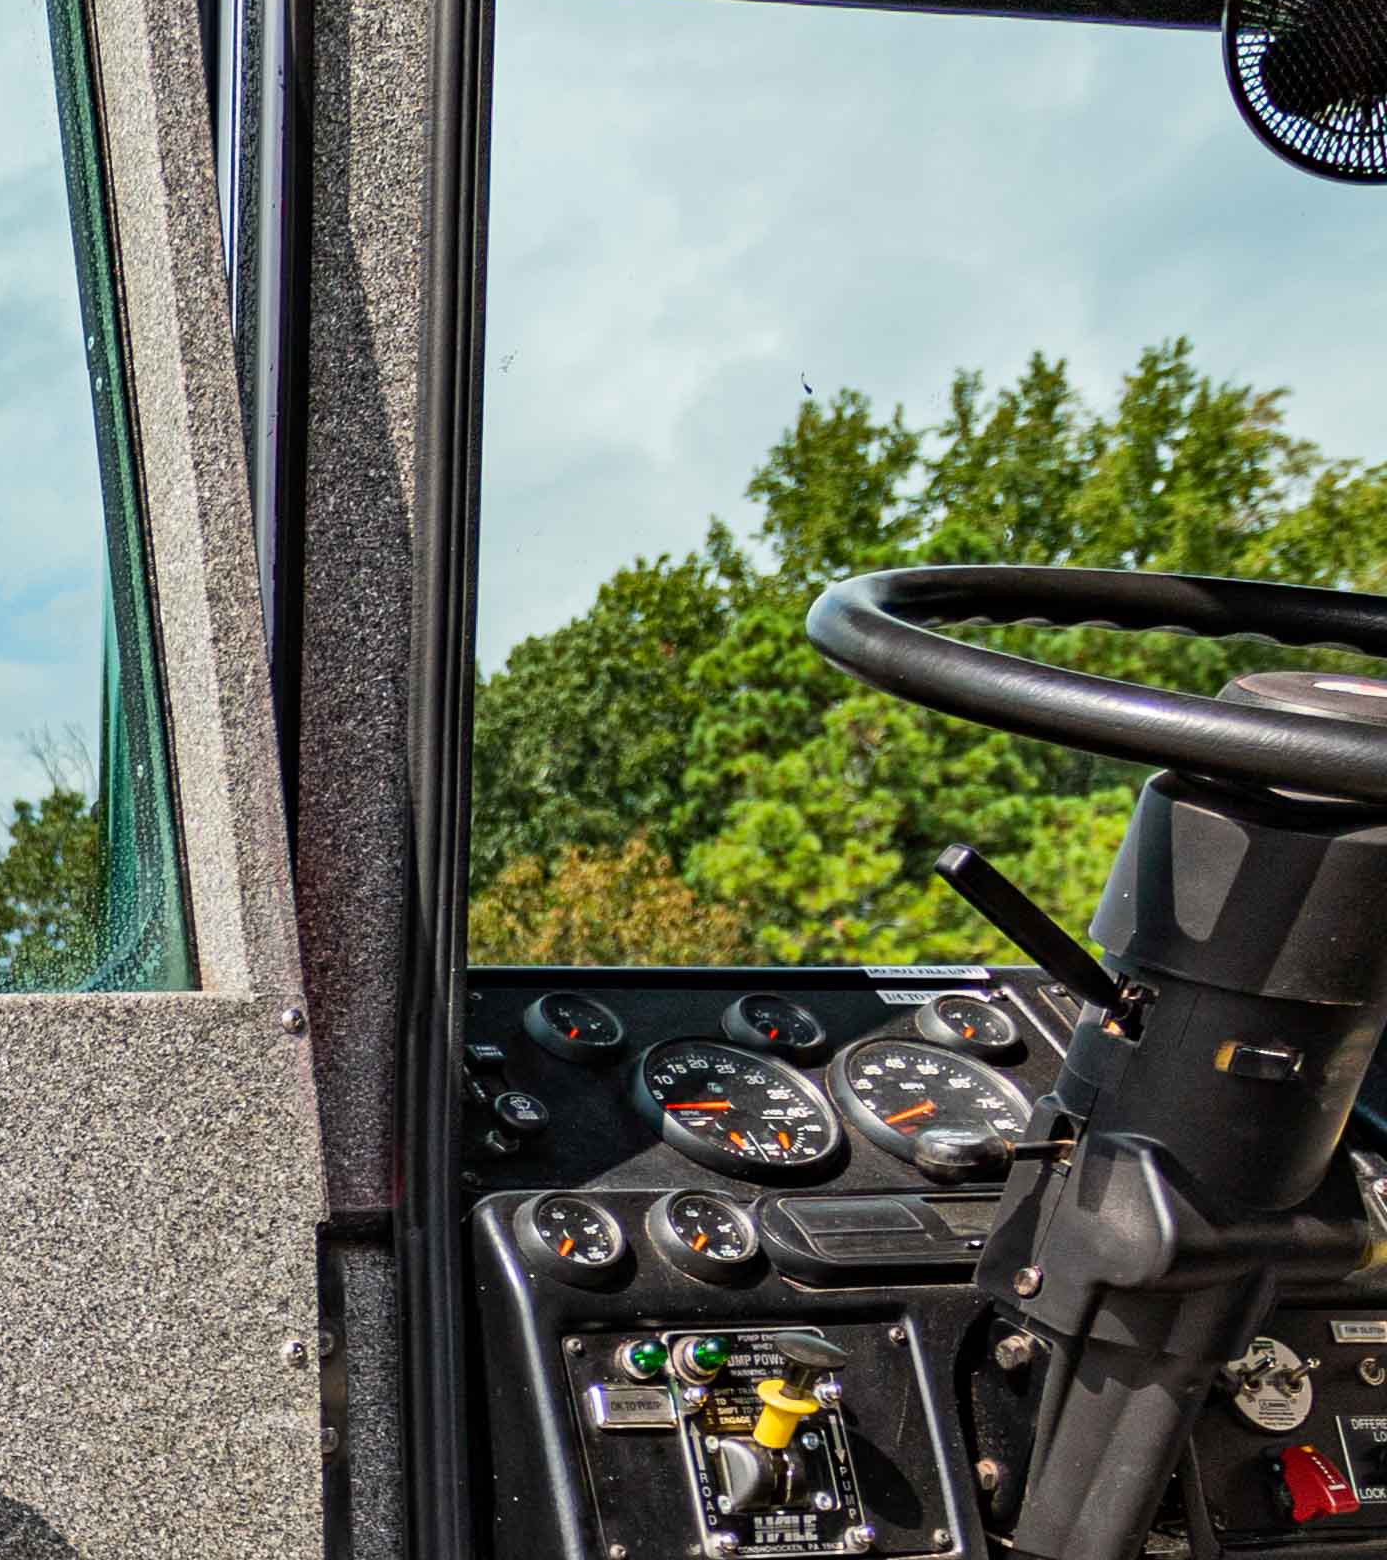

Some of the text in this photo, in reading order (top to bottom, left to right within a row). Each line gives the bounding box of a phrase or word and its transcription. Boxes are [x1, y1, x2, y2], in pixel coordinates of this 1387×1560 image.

[667, 1063, 687, 1075] 15
[687, 1058, 709, 1070] 20
[715, 1063, 736, 1075] 25
[653, 1074, 674, 1085] 10
[744, 1074, 766, 1085] 30
[699, 1472, 718, 1526] ROAD
[839, 1466, 857, 1520] PUMP
